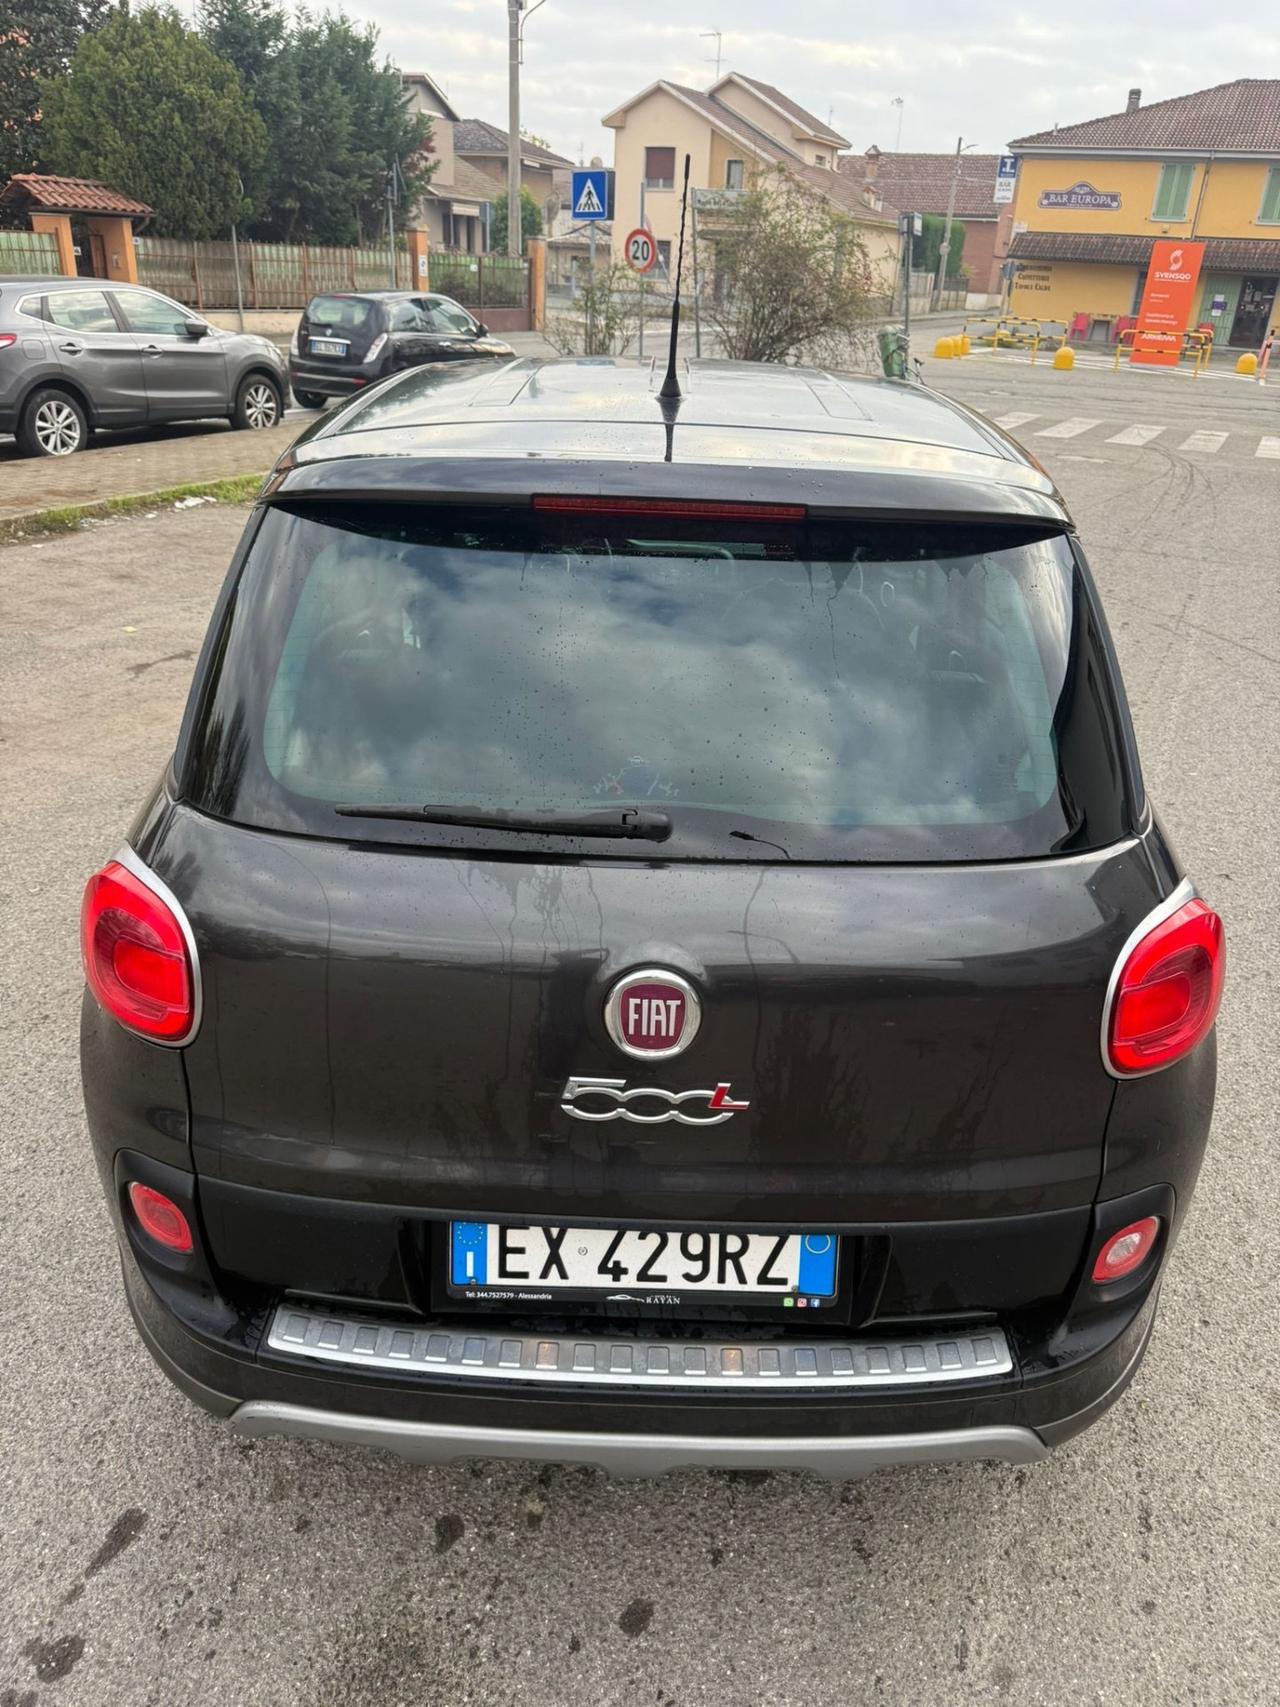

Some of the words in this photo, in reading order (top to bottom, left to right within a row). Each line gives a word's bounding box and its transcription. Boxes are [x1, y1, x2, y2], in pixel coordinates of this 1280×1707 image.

[1048, 194, 1069, 203] BAR
[1070, 195, 1112, 205] EUROPA
[632, 240, 650, 261] 20
[628, 998, 682, 1037] FIAT
[561, 1076, 751, 1126] 500L
[498, 1226, 569, 1280] EX
[597, 1231, 791, 1286] 429RZ
[518, 1292, 552, 1300] Alessandria
